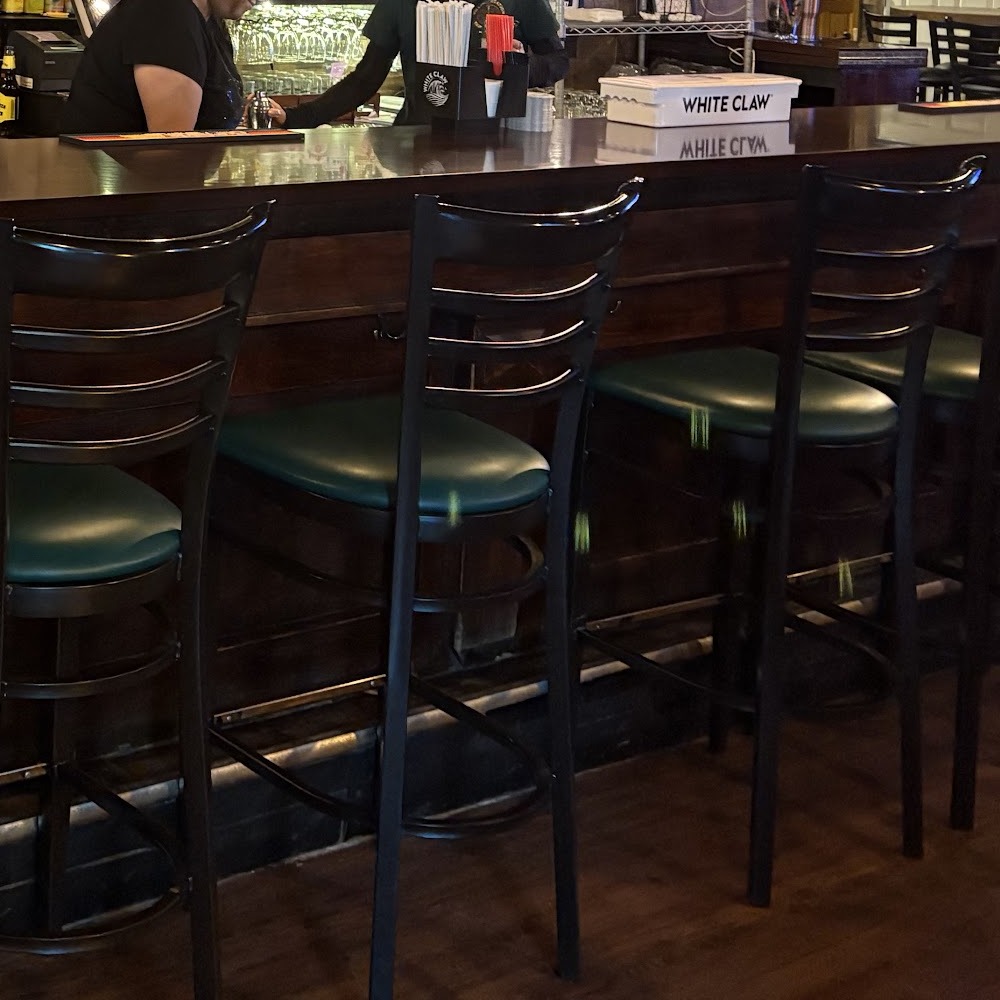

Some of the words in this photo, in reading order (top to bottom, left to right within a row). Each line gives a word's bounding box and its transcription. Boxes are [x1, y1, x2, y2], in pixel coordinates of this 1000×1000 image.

[422, 72, 434, 93] WHITE
[433, 70, 449, 85] CLAW
[682, 96, 729, 113] WHITE
[732, 94, 771, 112] CLAW
